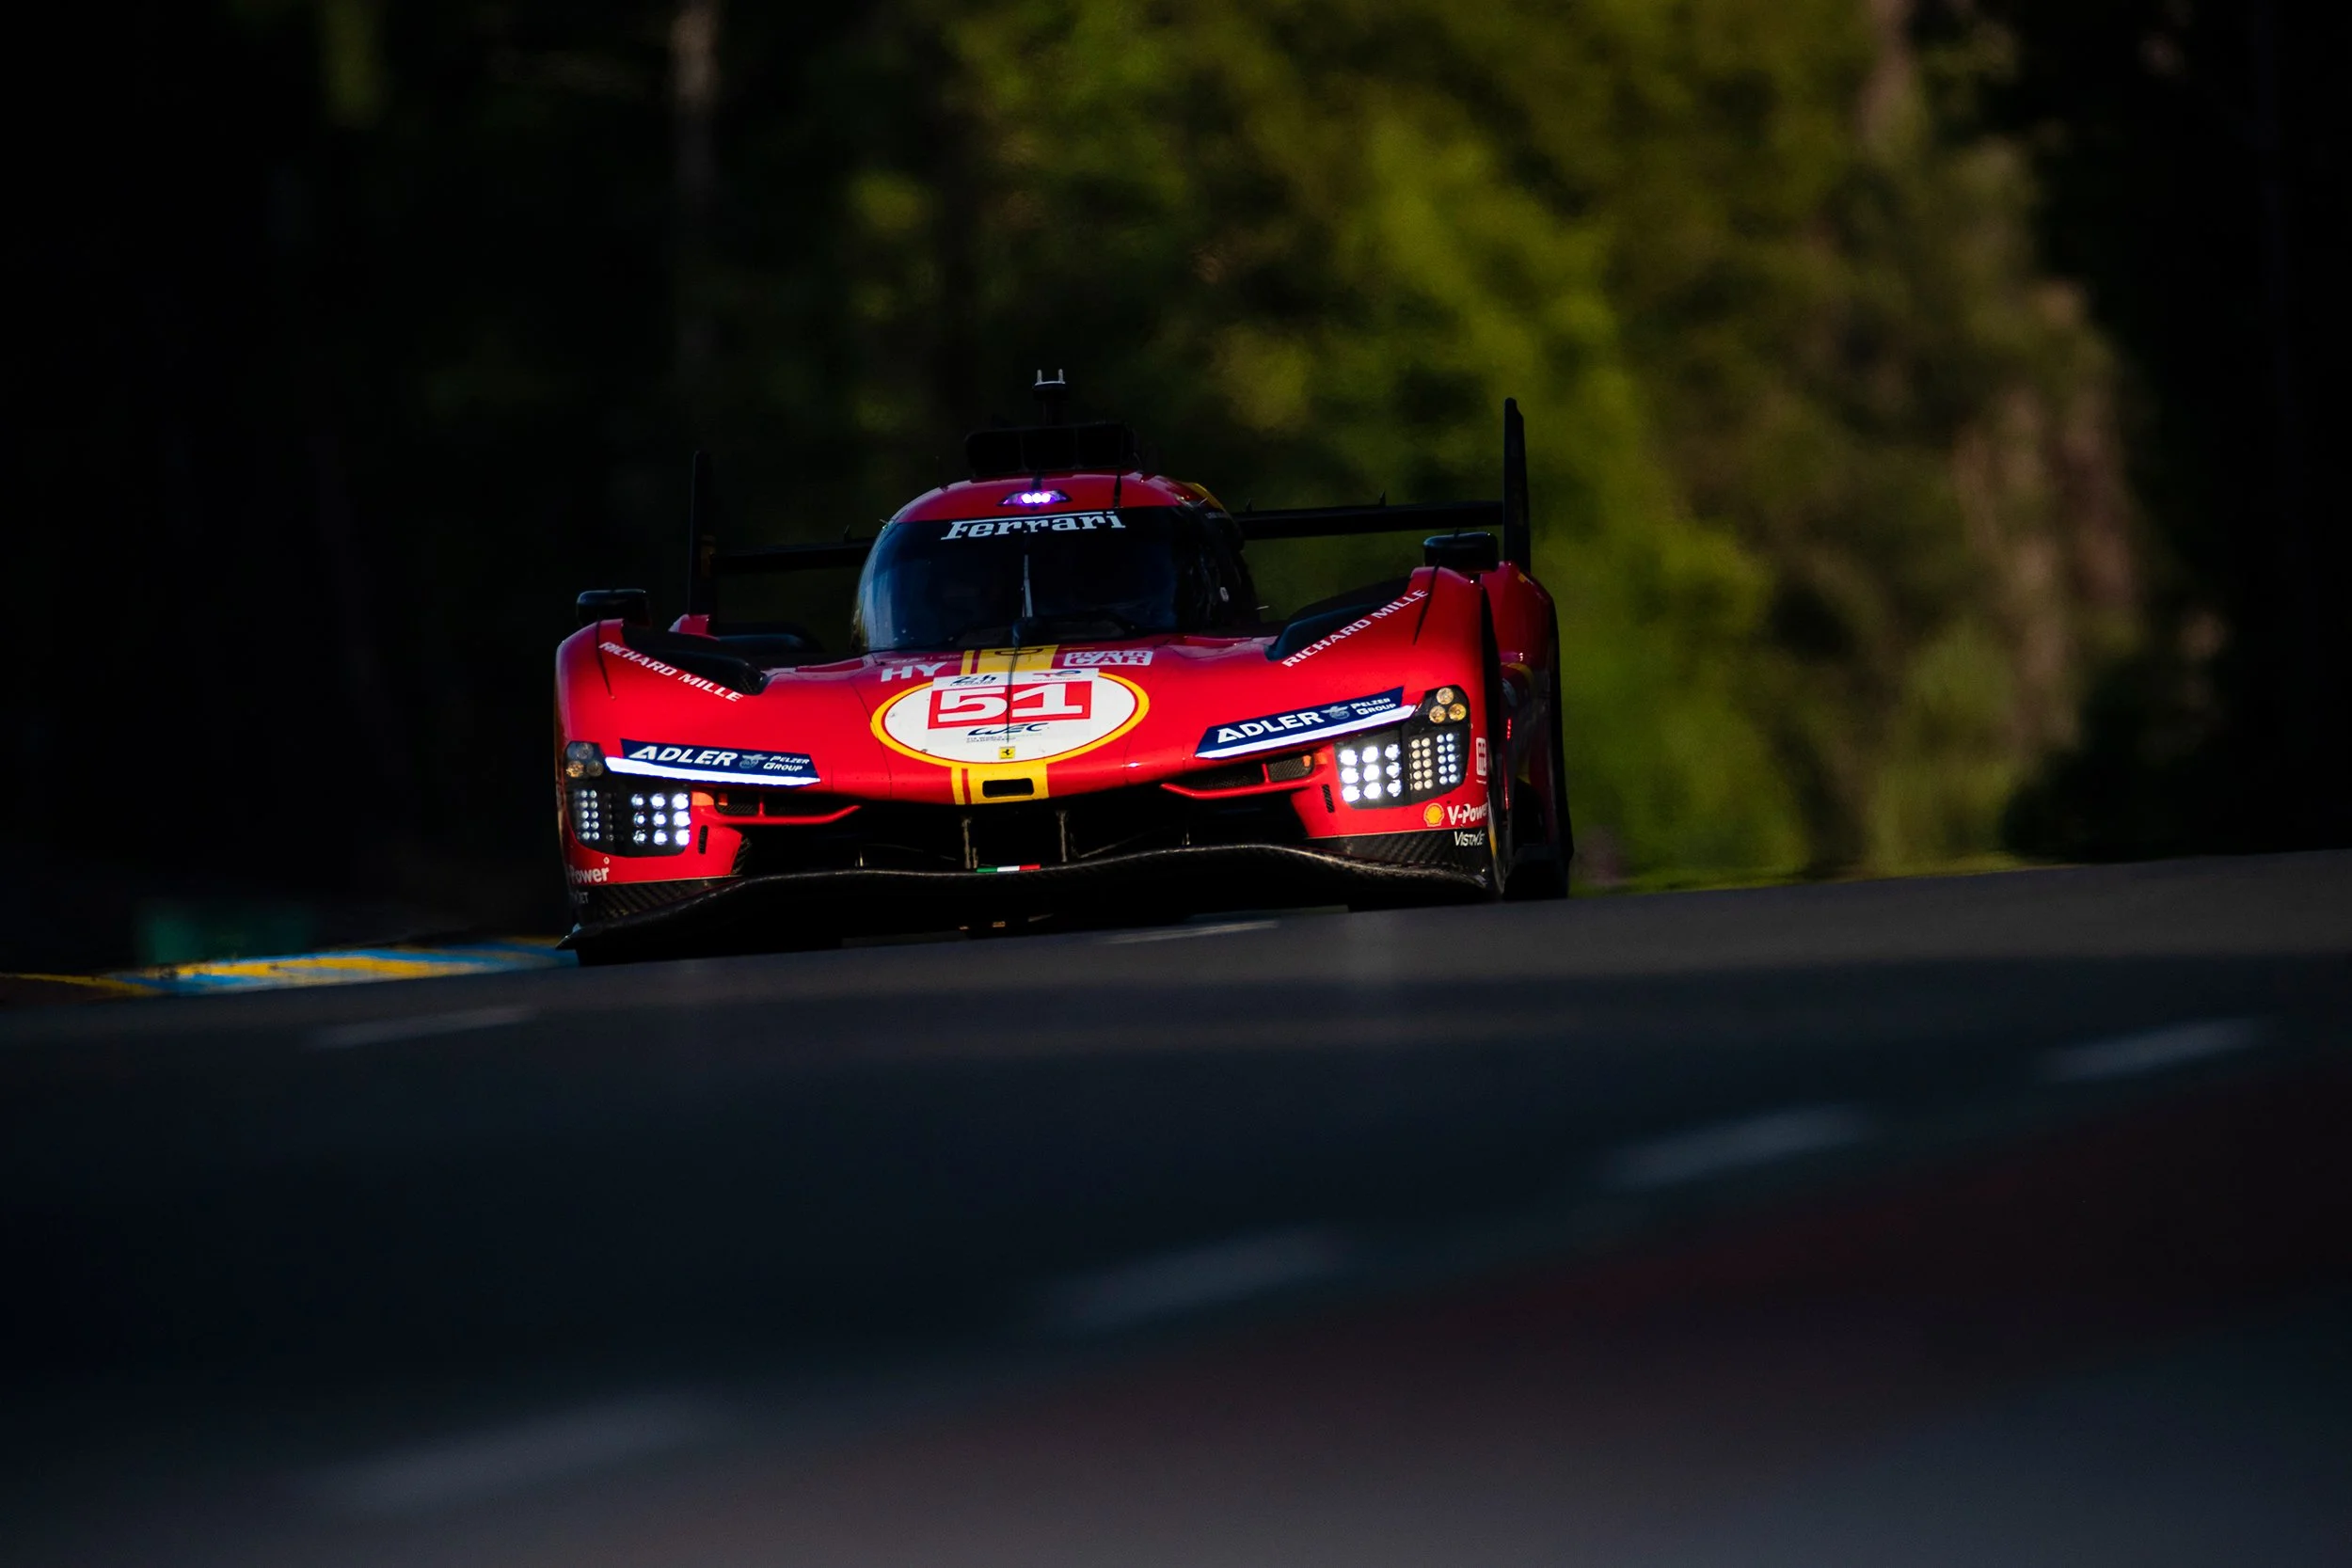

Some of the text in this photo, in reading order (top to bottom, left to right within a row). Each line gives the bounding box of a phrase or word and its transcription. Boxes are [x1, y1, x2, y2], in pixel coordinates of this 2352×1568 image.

[941, 511, 1126, 540] Ferrari
[1281, 589, 1429, 667] RICHARD MILLE
[1070, 656, 1146, 664] CAR
[598, 641, 743, 702] RICHARD MILLE
[881, 661, 948, 682] HY
[937, 683, 1083, 723] 51
[1356, 703, 1397, 716] GROUP
[967, 722, 1049, 736] WEC
[1217, 711, 1325, 744] ADLER
[628, 745, 739, 767] ADLER
[763, 762, 803, 772] GROUP
